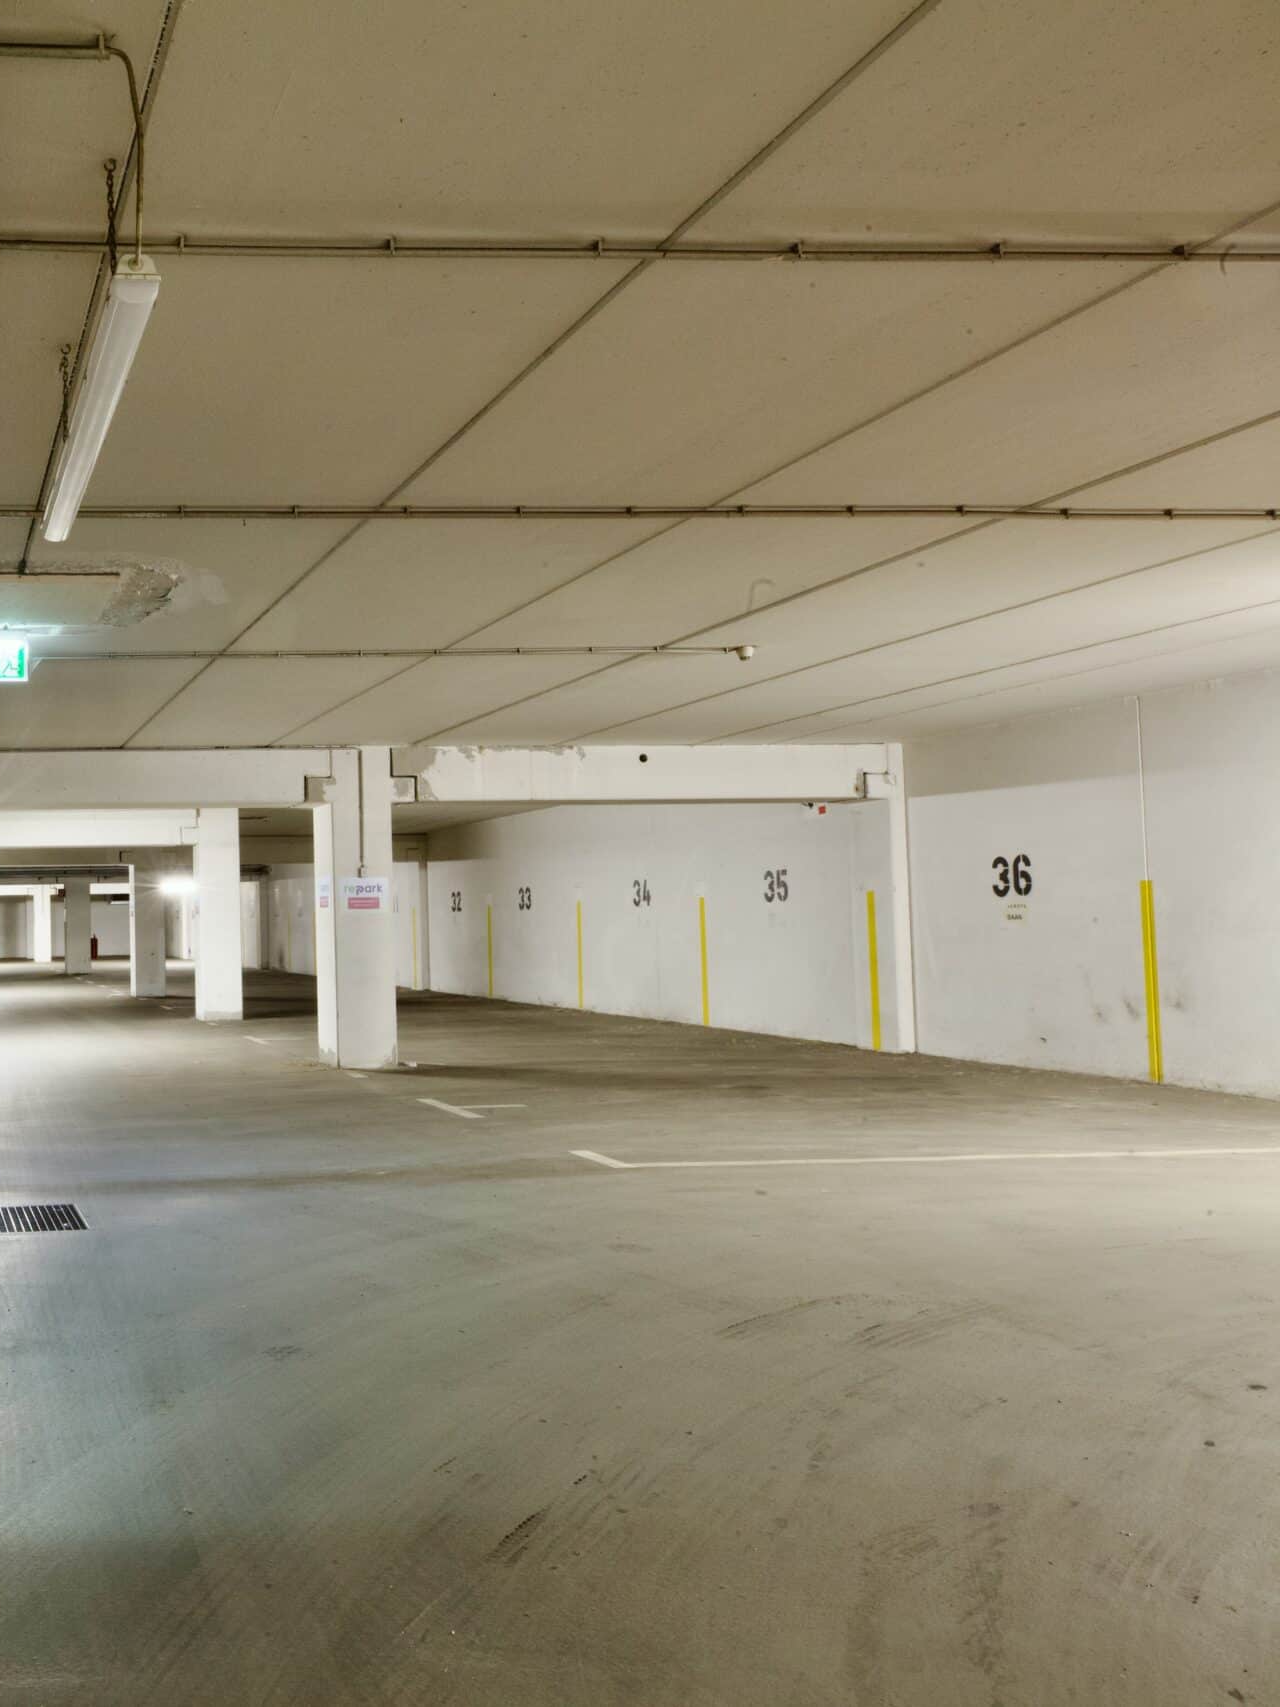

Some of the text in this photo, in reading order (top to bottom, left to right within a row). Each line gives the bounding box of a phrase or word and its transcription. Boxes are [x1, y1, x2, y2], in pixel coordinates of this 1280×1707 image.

[764, 869, 788, 902] 35
[992, 854, 1032, 897] 36
[344, 884, 383, 896] repark
[451, 891, 462, 912] 32
[518, 887, 531, 910] 33
[633, 880, 651, 906] 34
